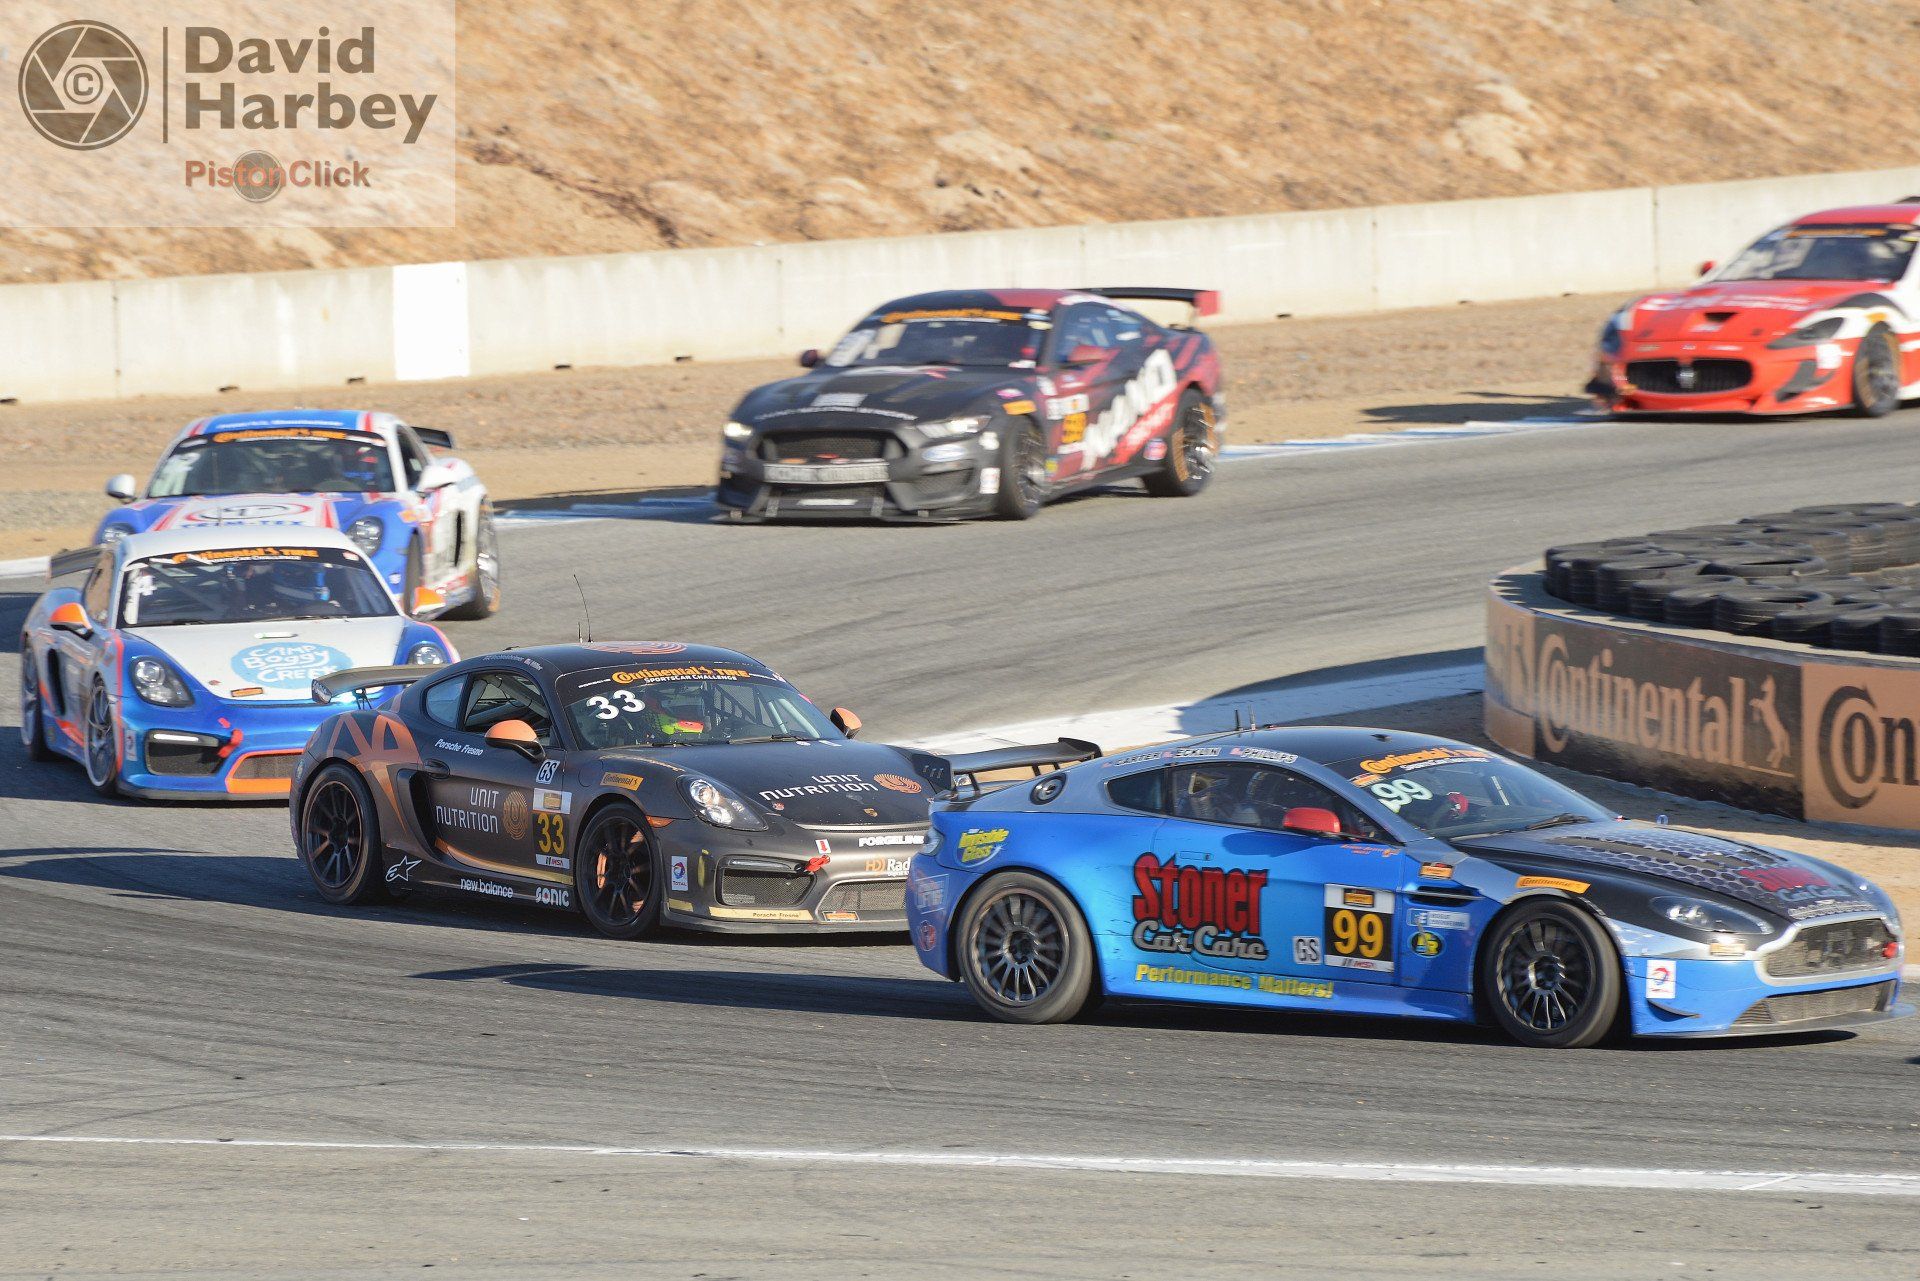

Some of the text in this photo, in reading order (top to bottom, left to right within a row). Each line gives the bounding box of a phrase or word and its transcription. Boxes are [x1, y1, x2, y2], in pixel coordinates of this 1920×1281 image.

[243, 651, 329, 670] Boggy
[249, 645, 316, 657] CAMP
[612, 666, 751, 684] Continental TIRE
[586, 689, 646, 720] 33
[1537, 633, 1746, 768] Continental
[434, 738, 484, 756] Porsche Fresno
[538, 761, 558, 782] GS
[812, 774, 863, 784] UNIT
[470, 787, 500, 809] UNIT
[758, 782, 879, 801] NUTRITION
[1370, 778, 1434, 813] 99
[436, 805, 499, 834] NUTRITION
[537, 812, 565, 855] 33
[460, 878, 514, 899] new balance
[535, 887, 570, 907] SONIC
[1133, 852, 1270, 937] Stoner
[1133, 919, 1268, 961] Car Care
[1332, 909, 1384, 958] 99
[1296, 938, 1320, 962] GS
[1135, 964, 1335, 998] Performance Matters!
